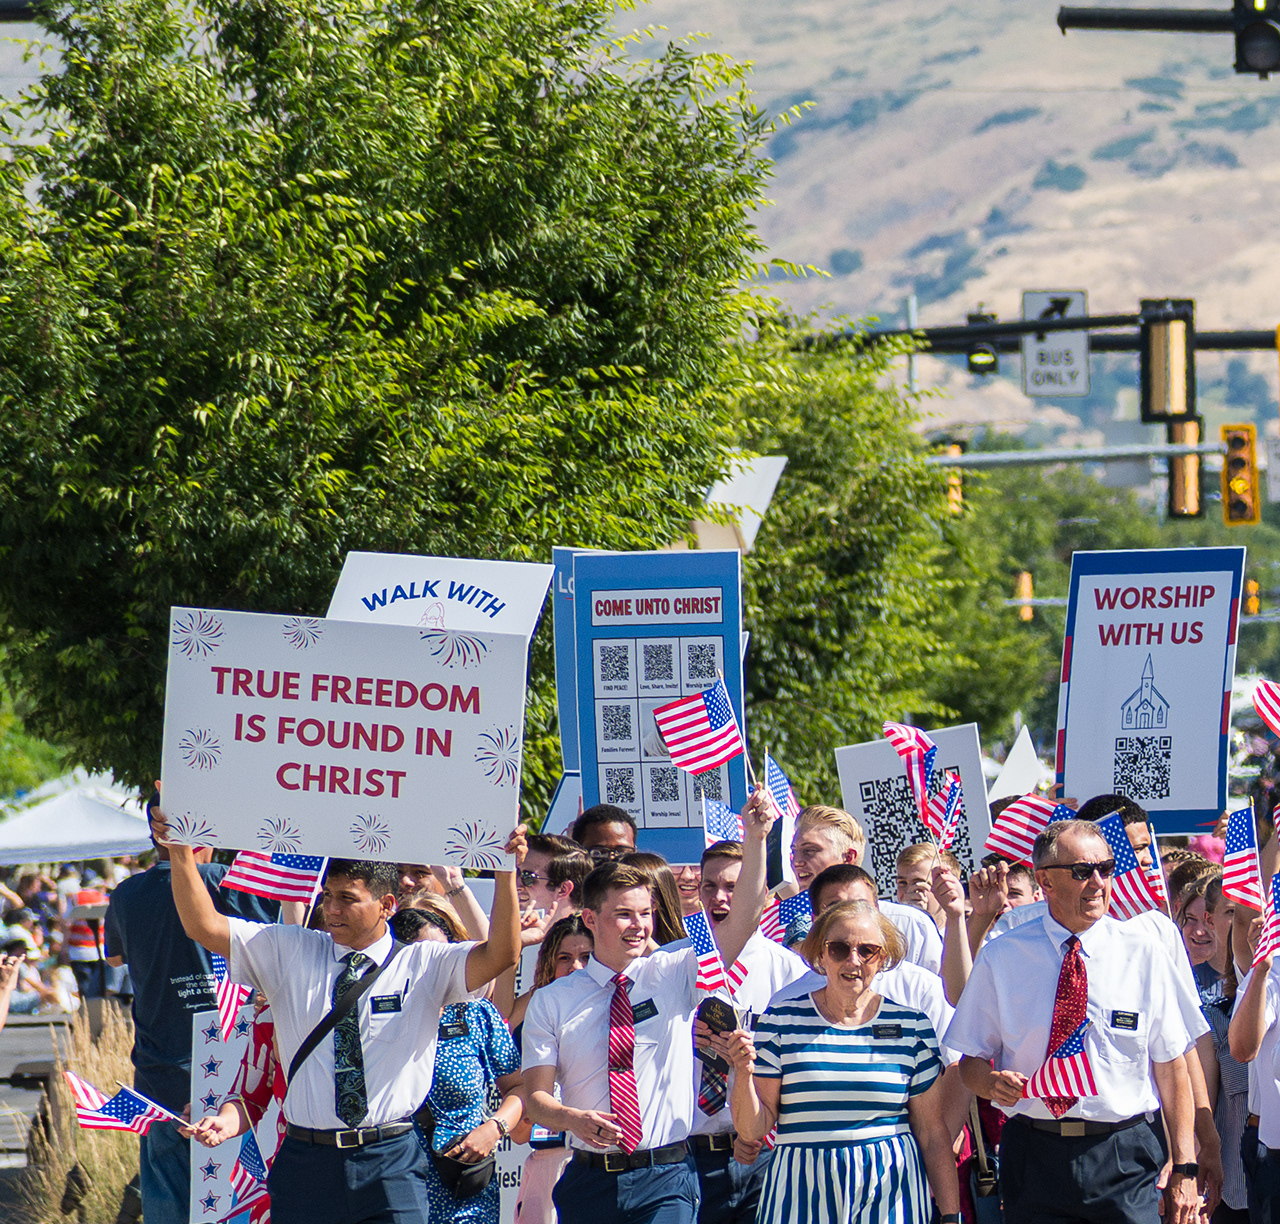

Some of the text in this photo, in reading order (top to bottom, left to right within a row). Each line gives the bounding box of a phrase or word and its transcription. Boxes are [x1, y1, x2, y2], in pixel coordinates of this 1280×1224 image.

[1038, 350, 1074, 366] BUS
[1033, 370, 1079, 386] ONLY
[361, 580, 506, 619] WALK WITH
[595, 596, 721, 617] COME UNTO CHRIST
[1094, 585, 1215, 610] WORSHIP
[1098, 621, 1204, 647] WITH US
[211, 666, 480, 715] TRUE FREEDOM
[234, 713, 452, 757] IS FOUND IN
[276, 762, 406, 798] CHRIST
[170, 974, 194, 984] Instead
[177, 988, 195, 998] light
